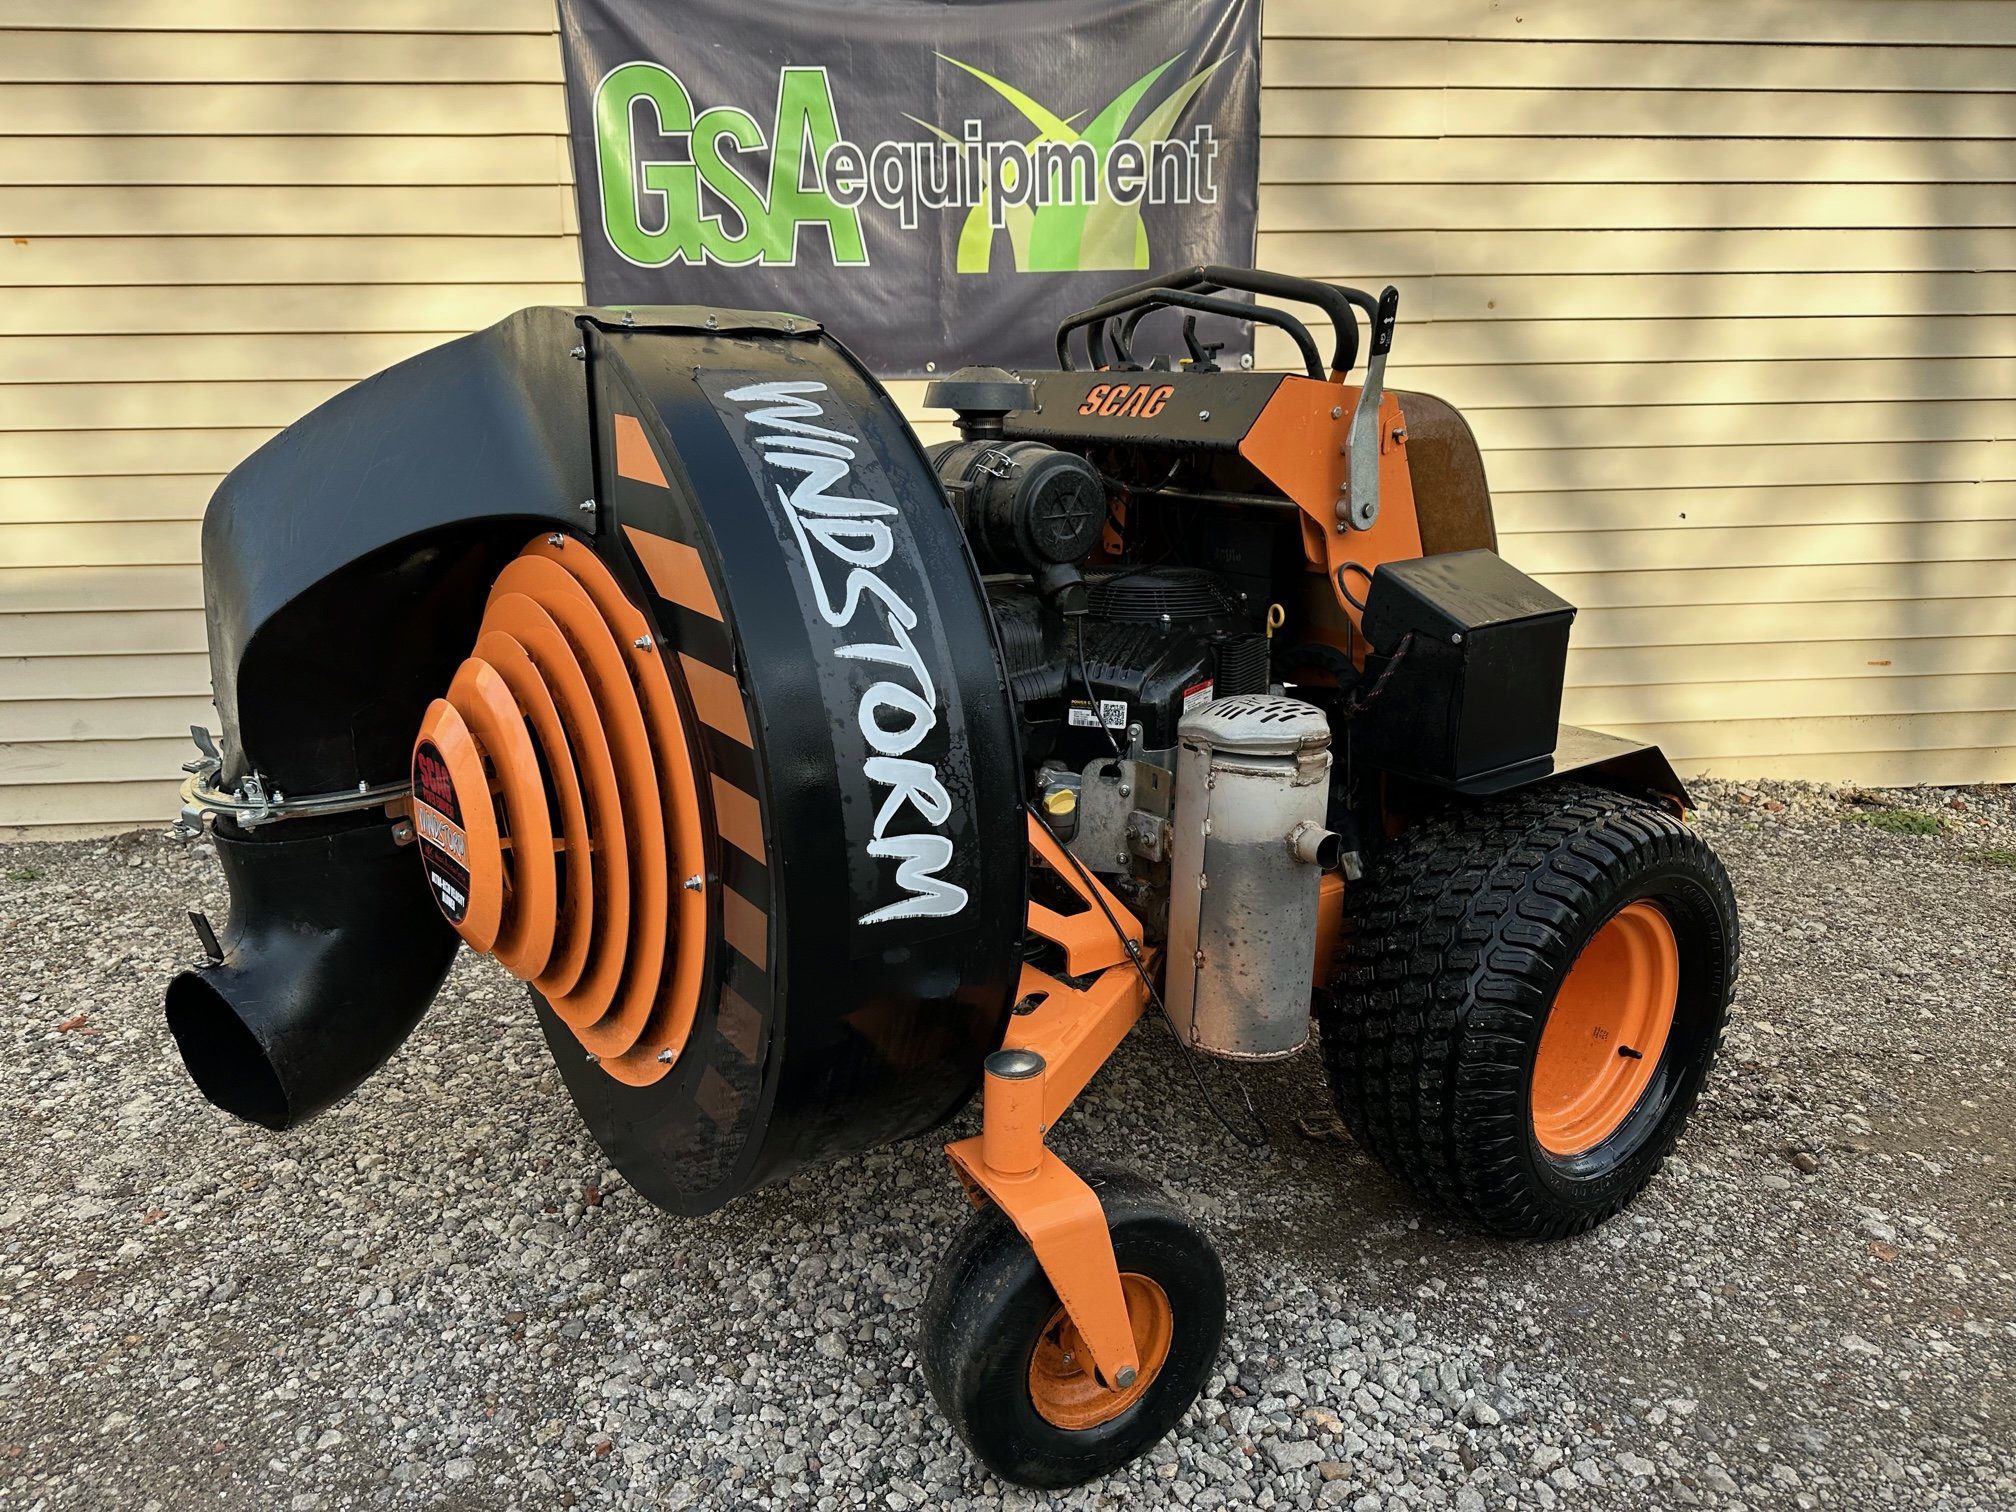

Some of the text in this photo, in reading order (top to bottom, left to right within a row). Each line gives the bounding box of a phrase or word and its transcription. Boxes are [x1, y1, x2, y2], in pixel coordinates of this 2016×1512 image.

[822, 119, 1219, 230] equipment
[1078, 383, 1175, 418] SCAG
[723, 380, 969, 926] WINDSTORM
